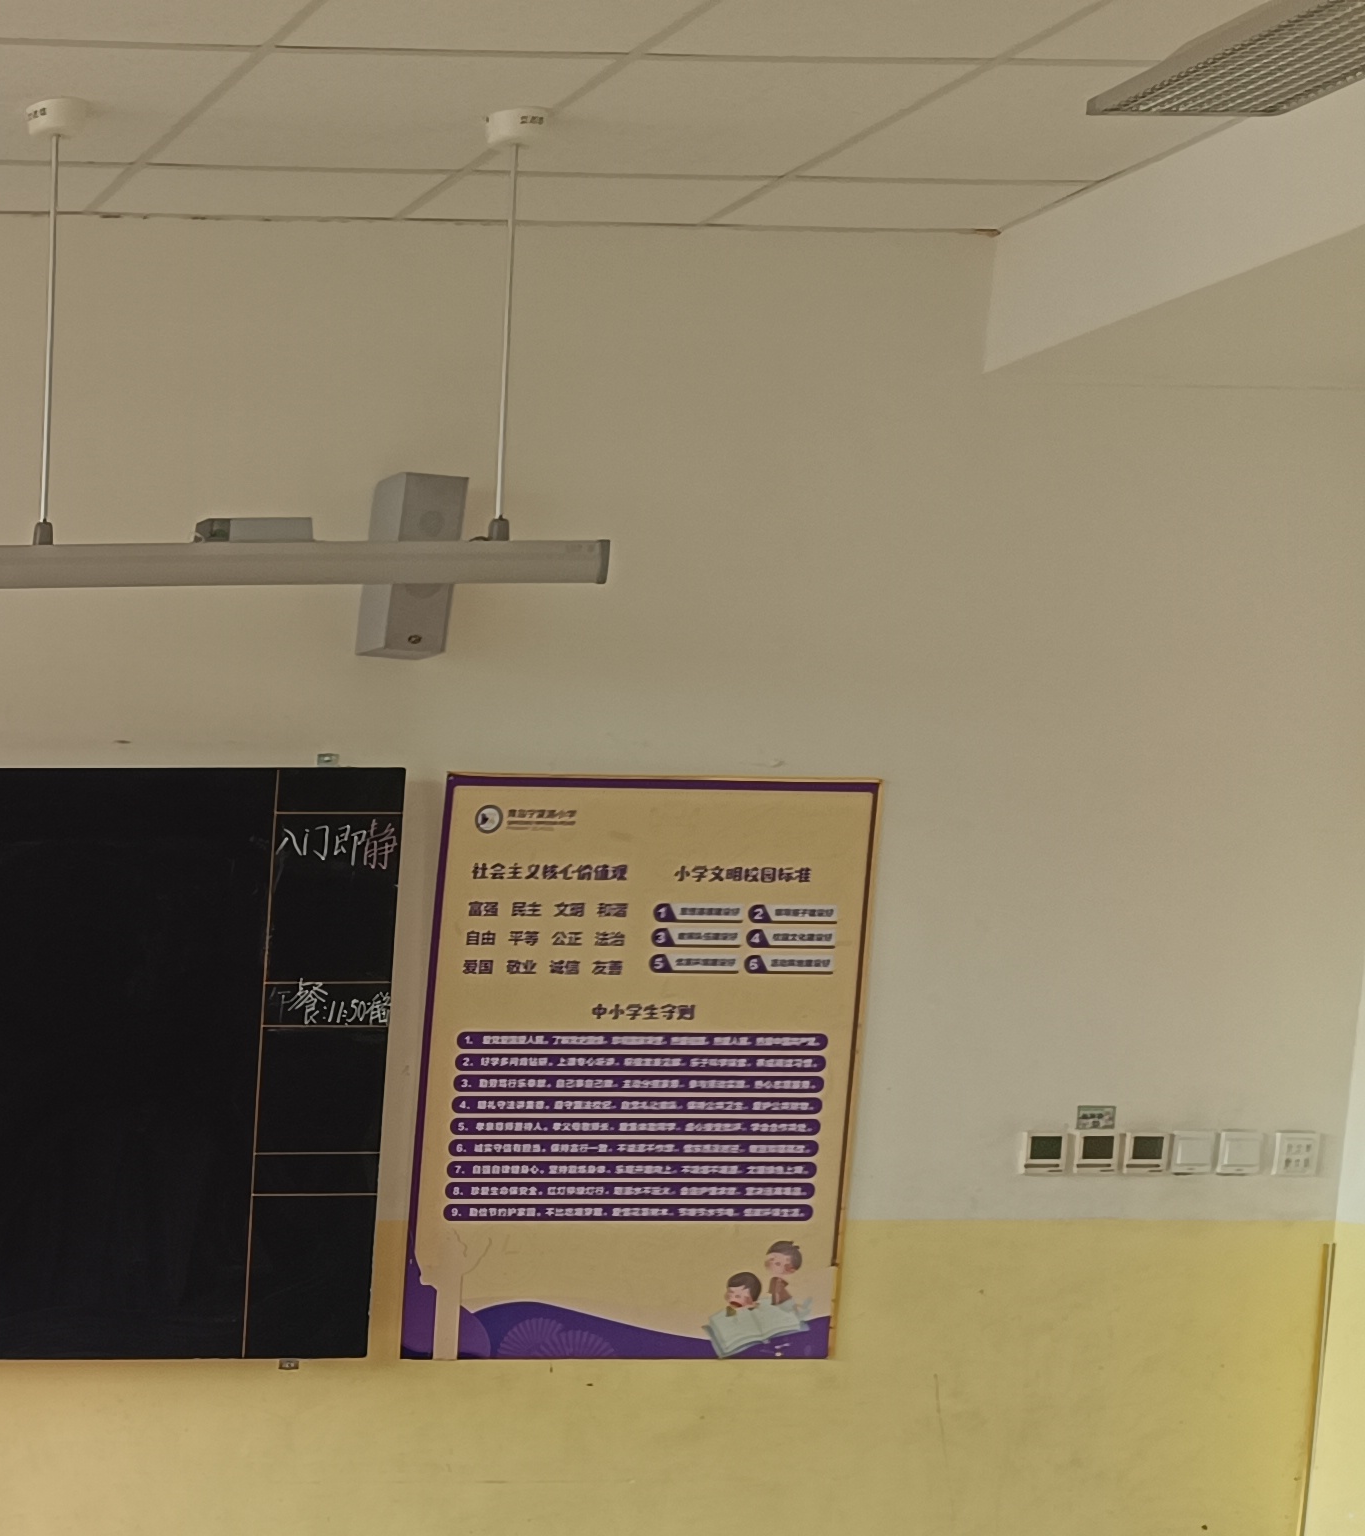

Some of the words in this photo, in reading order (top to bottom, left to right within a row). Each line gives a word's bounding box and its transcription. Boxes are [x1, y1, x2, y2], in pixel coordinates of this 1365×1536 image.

[472, 863, 628, 881] 社会主义核心价值观
[674, 865, 812, 883] 小学文明校园标准
[468, 901, 499, 917] 富强
[511, 902, 542, 917] 民主
[554, 902, 585, 918] 文明
[656, 907, 667, 918] 1
[753, 908, 764, 919] 2
[465, 931, 496, 946] 自由
[508, 931, 539, 946] 平等
[551, 931, 583, 947] 公正
[594, 931, 625, 947] 法治
[655, 932, 666, 943] 3
[750, 933, 761, 944] 4
[463, 960, 494, 975] 爱国
[506, 960, 537, 975] 敬业
[549, 960, 581, 975] 诚信
[592, 960, 623, 976] 友善
[653, 957, 665, 969] 5
[749, 959, 759, 970] 6
[591, 1003, 696, 1020] 中小学生守则
